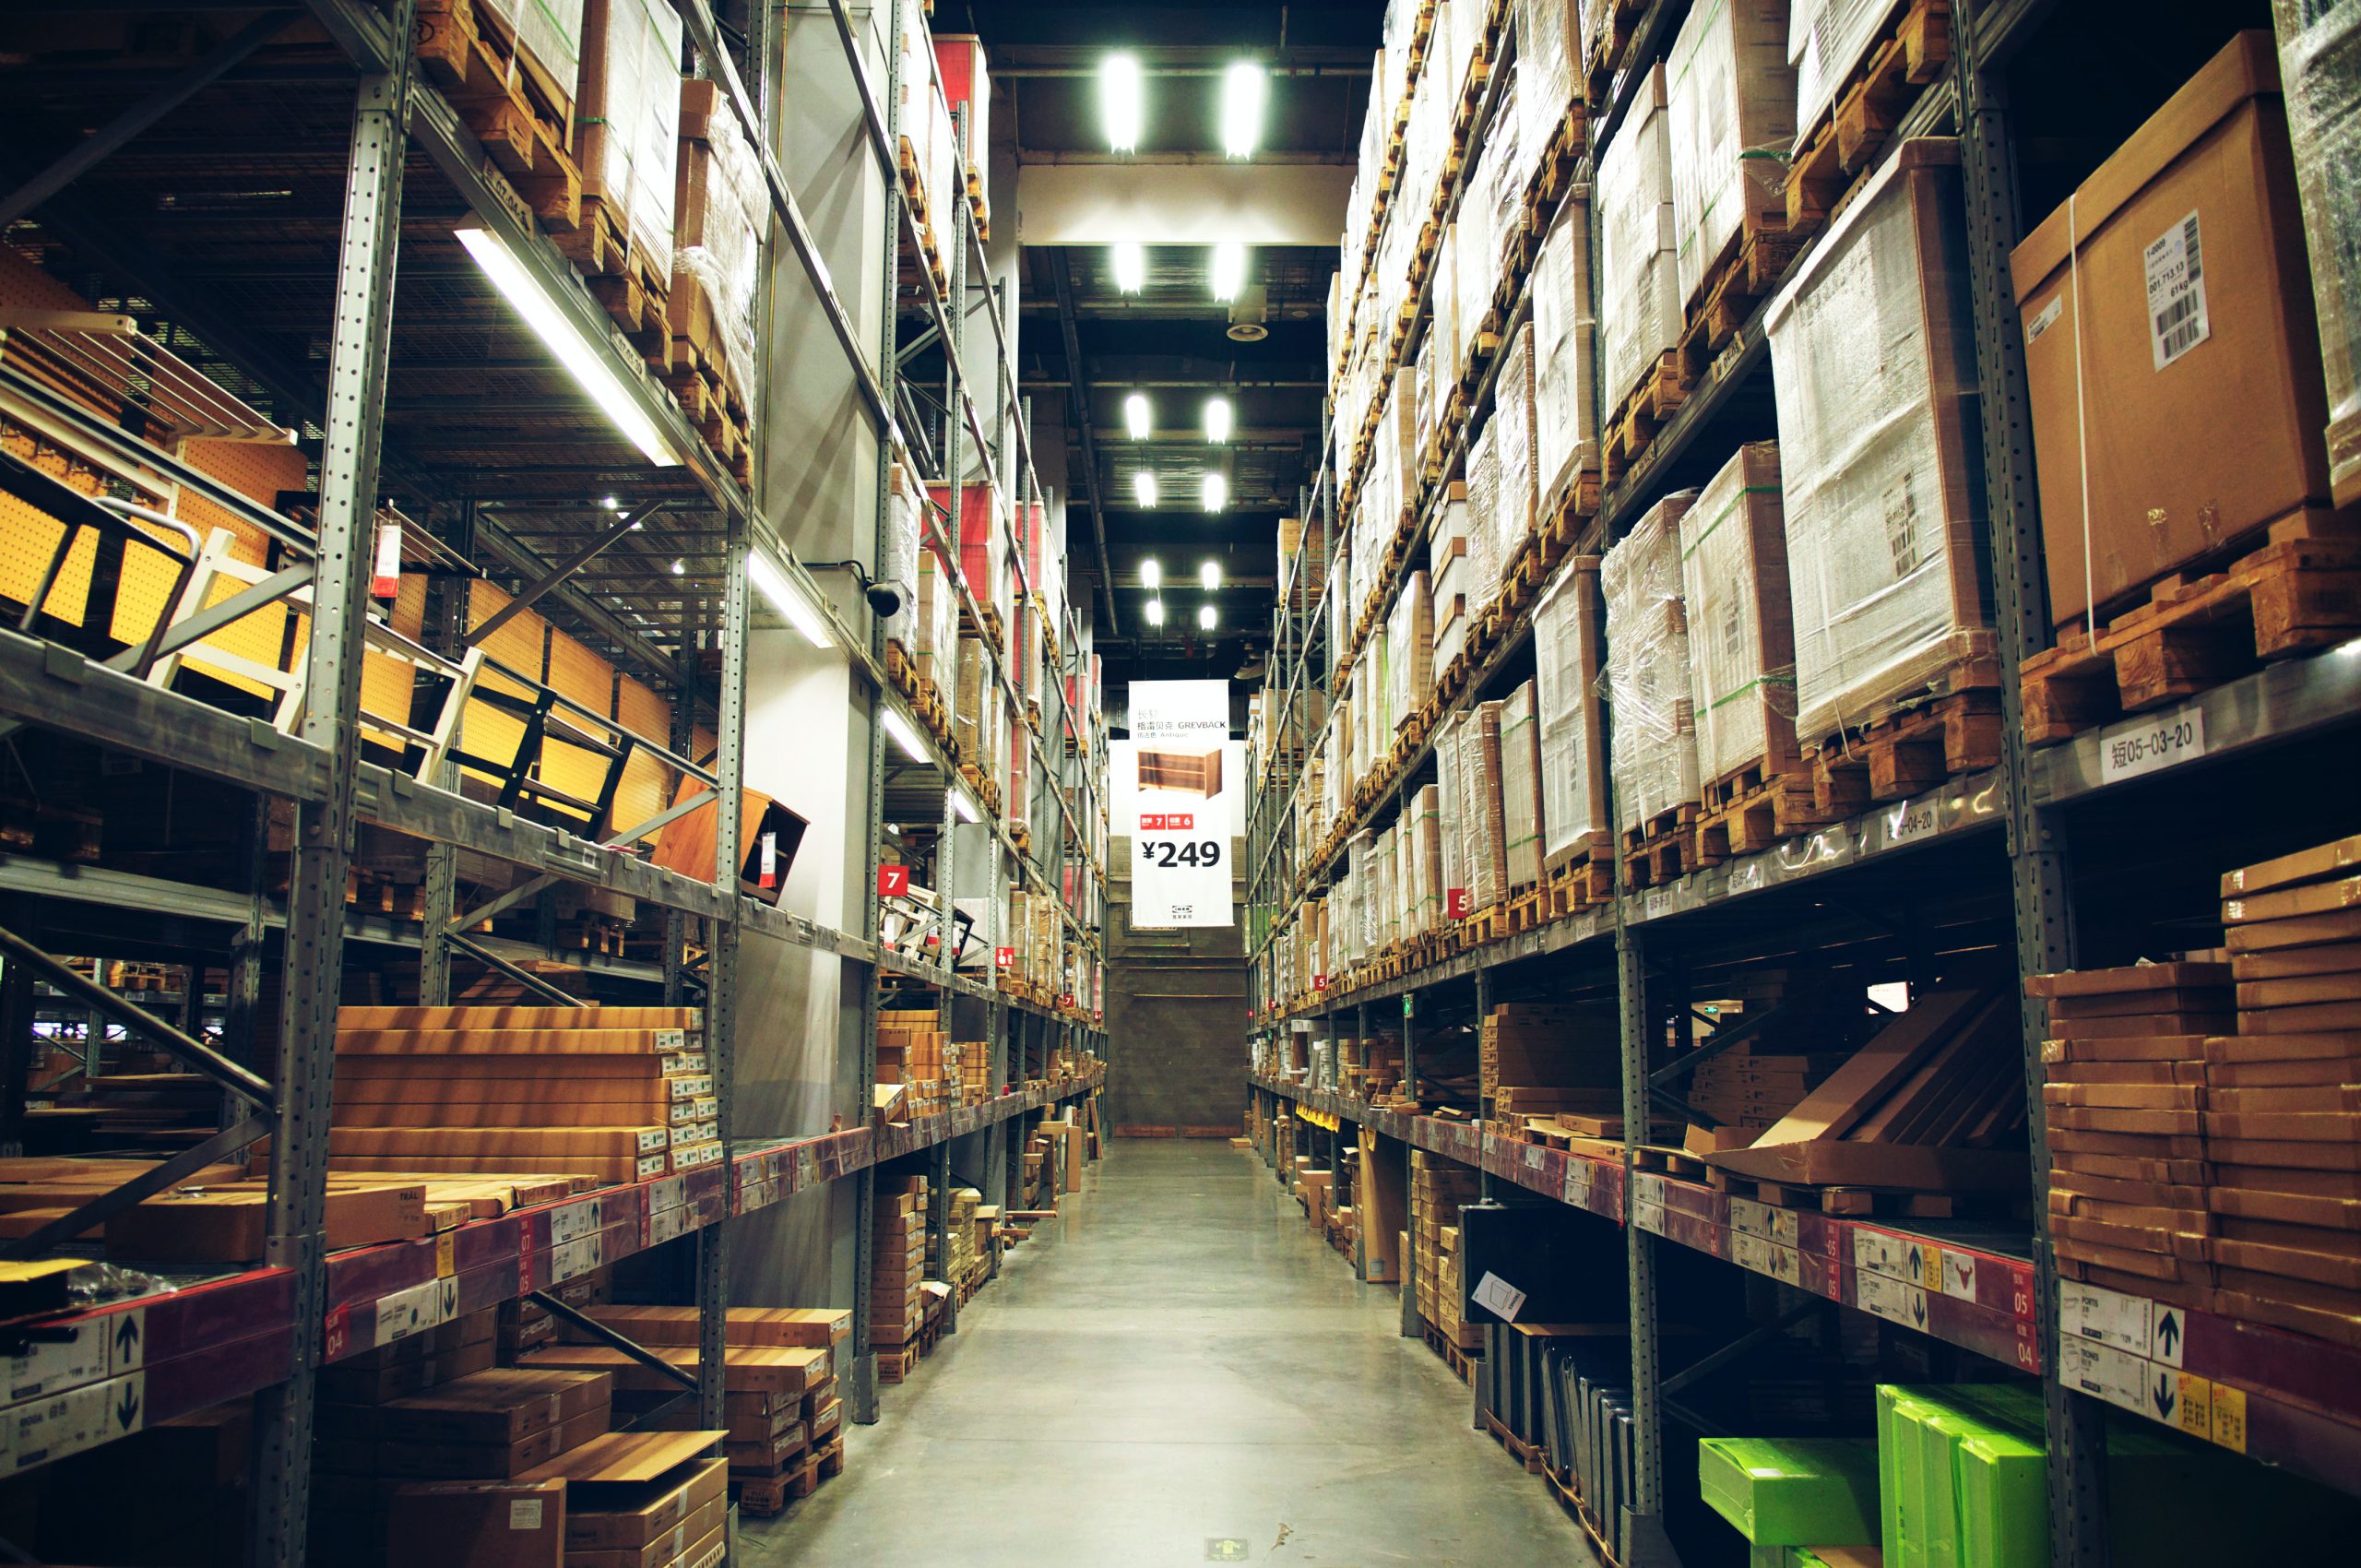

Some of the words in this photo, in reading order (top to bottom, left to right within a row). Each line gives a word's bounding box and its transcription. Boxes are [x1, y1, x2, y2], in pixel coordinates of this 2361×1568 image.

[2112, 721, 2192, 769] 短05-03-20
[1155, 816, 1163, 826] 7
[1183, 816, 1191, 826] 6
[887, 872, 900, 889] 7
[1457, 895, 1467, 912] 5
[1319, 978, 1324, 987] 5
[1063, 997, 1071, 1005] 7
[521, 1234, 531, 1252] 07
[1827, 1239, 1836, 1256] 05
[519, 1274, 529, 1293] 05
[1828, 1278, 1836, 1296] 05
[2014, 1291, 2027, 1314] 05
[328, 1330, 343, 1356] 04
[2018, 1342, 2033, 1366] 04
